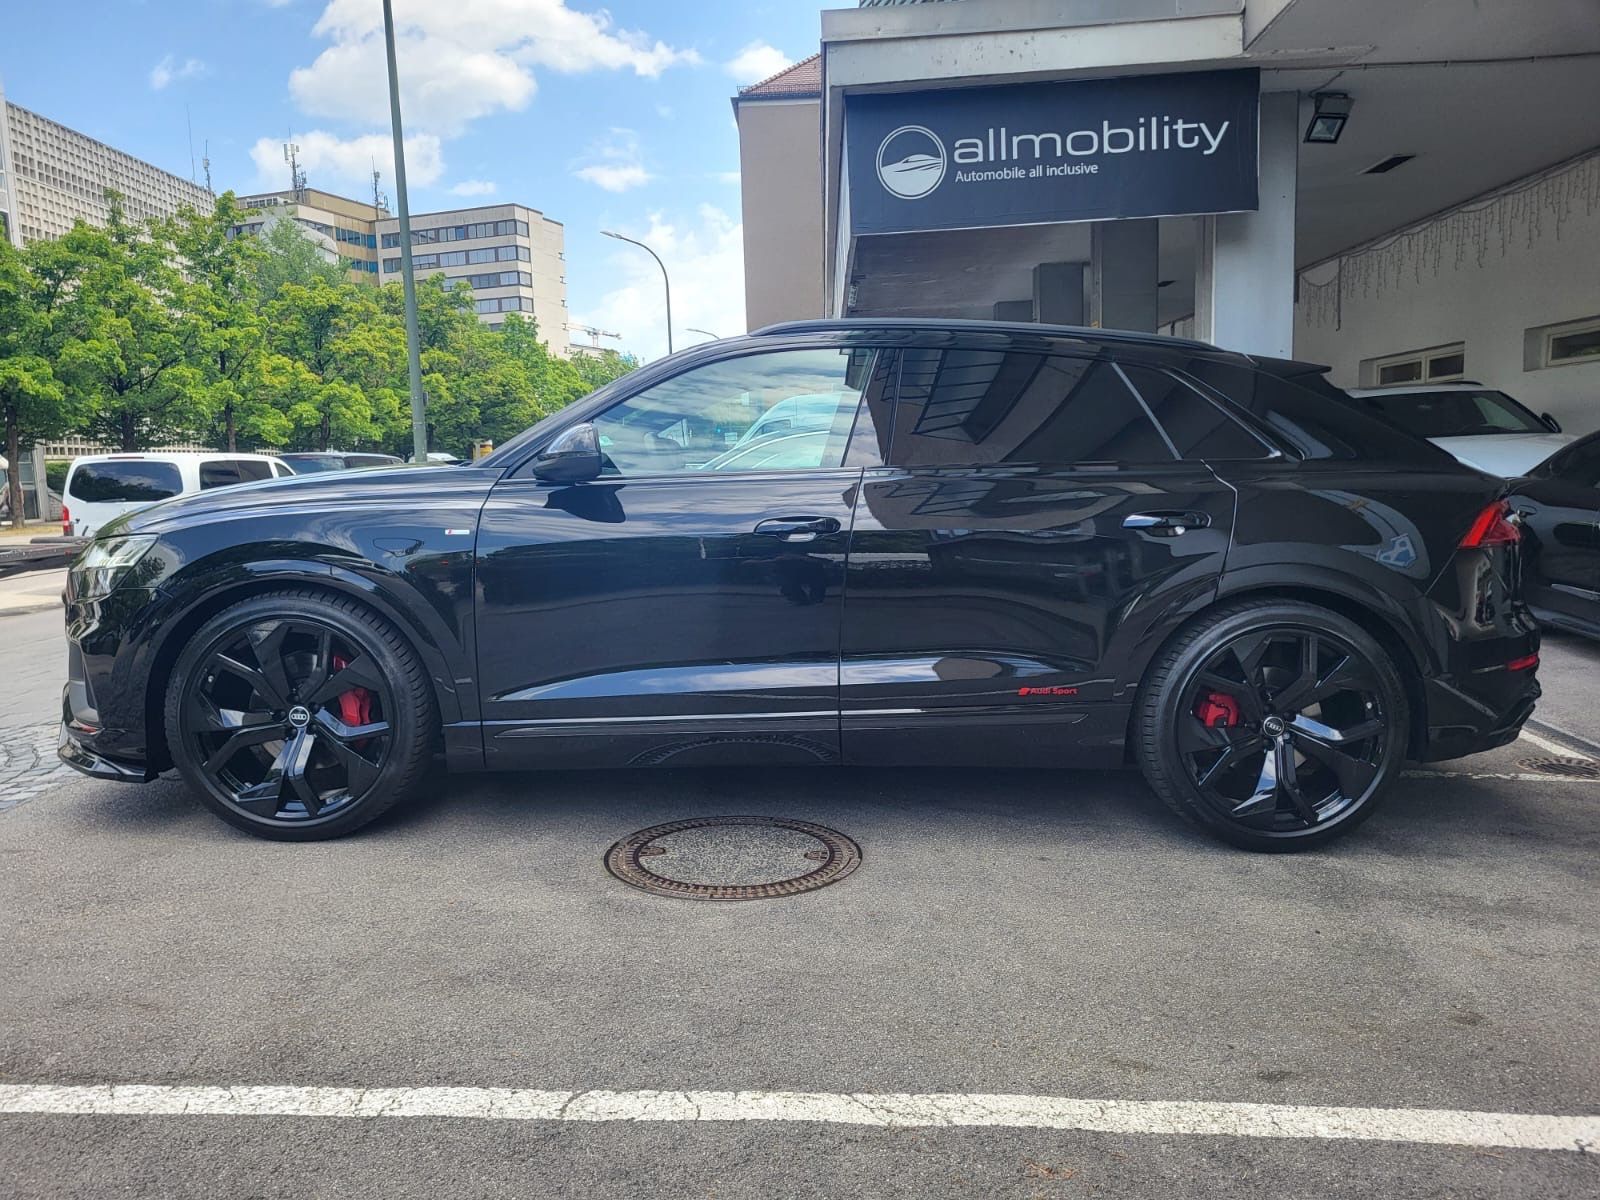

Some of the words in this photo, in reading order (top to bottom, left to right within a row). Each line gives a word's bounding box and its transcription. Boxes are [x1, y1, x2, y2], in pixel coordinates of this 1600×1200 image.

[953, 116, 1230, 164] allmobility
[954, 165, 1026, 183] Automobile
[1029, 164, 1043, 178] all
[1046, 162, 1099, 177] inclusive
[1053, 687, 1078, 696] Sport
